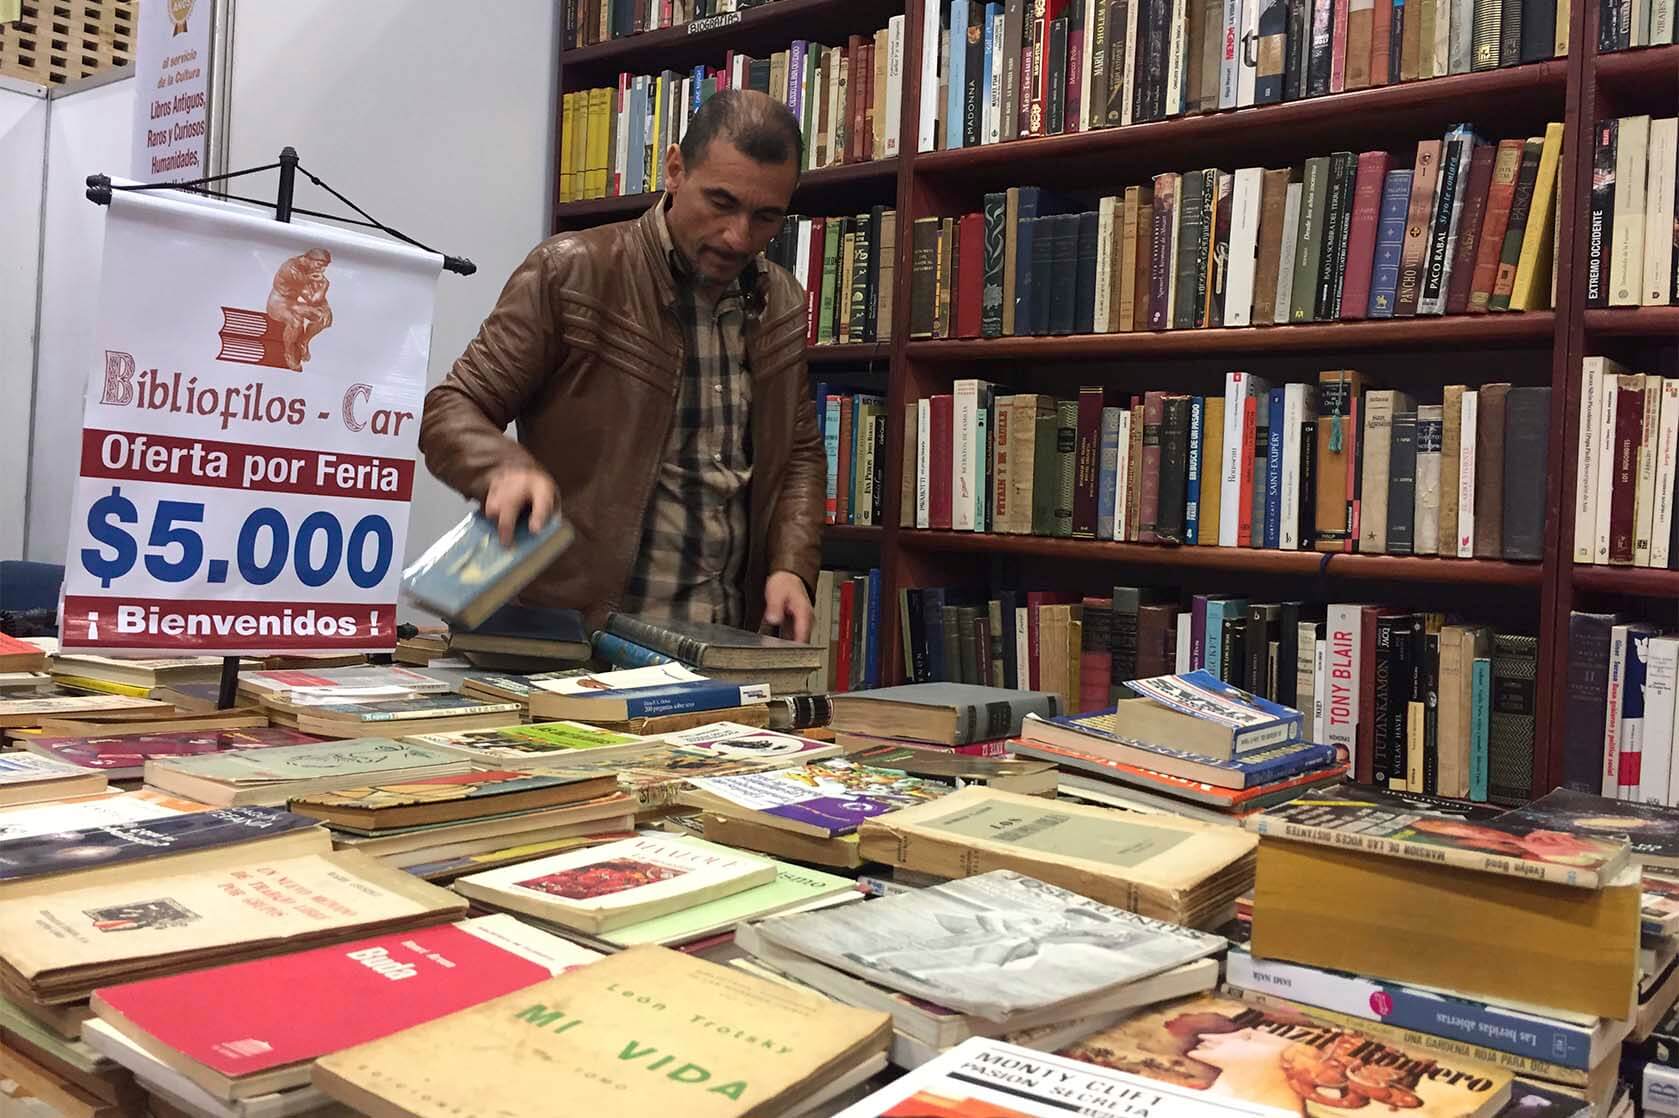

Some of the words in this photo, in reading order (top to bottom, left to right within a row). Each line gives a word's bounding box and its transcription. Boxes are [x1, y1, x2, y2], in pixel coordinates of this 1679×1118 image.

[1097, 8, 1106, 45] SHOLEM
[170, 49, 198, 67] servicio
[1093, 50, 1105, 76] MARÍA
[175, 67, 201, 84] Cultura
[151, 100, 172, 121] Libros
[172, 91, 207, 115] Antiguos,
[967, 79, 976, 135] MADONNA
[147, 130, 167, 148] Raros
[168, 131, 172, 147] y
[174, 119, 206, 142] Curiosos
[151, 149, 200, 175] Humanidades,
[1512, 180, 1530, 221] PASCAL
[1327, 223, 1337, 253] SOMBRA
[1432, 231, 1447, 261] RABAL
[1590, 209, 1603, 258] OCCIDENTE
[1400, 269, 1416, 303] PANCHO
[1430, 263, 1443, 290] PACO
[1588, 258, 1601, 299] EXTREMO
[1191, 403, 1200, 430] PASADO
[1190, 439, 1199, 449] DE
[101, 433, 228, 478] Oferta
[242, 451, 306, 487] por
[316, 454, 399, 492] Feria
[998, 467, 1006, 475] Y
[1189, 449, 1198, 471] BUSCA
[1269, 431, 1280, 496] SAINT-EXUPÉRY
[80, 486, 394, 589] $5.000
[116, 605, 358, 637] Bienvenidos
[369, 610, 380, 637] !
[1331, 631, 1353, 680] BLAIR
[1330, 683, 1352, 725] TONY
[1374, 658, 1390, 760] TUTANKAMÓN
[1382, 626, 1391, 648] JACQ
[1393, 712, 1402, 738] HAVEL
[1393, 742, 1402, 774] VACLAV
[988, 817, 1020, 830] LOS
[1285, 825, 1332, 844] DISTANTES
[1335, 832, 1364, 848] VOCES
[1366, 838, 1385, 852] LAS
[1388, 842, 1401, 854] DE
[1403, 845, 1446, 862] MANSION
[1484, 857, 1511, 874] Bond
[1513, 863, 1546, 879] Evelyn
[345, 945, 418, 981] Buda
[1273, 975, 1292, 988] SAMI
[605, 982, 668, 1012] León
[689, 1014, 794, 1055] Trotsky
[1435, 1012, 1478, 1034] abiertas
[1478, 1021, 1517, 1041] heridas
[514, 1003, 584, 1035] MI
[617, 1039, 752, 1102] VIDA
[1404, 1032, 1422, 1046] UNA
[1425, 1036, 1471, 1057] GARDENIA
[1500, 1053, 1525, 1069] PARA
[1519, 1031, 1538, 1047] Las
[960, 1061, 1040, 1089] PASION
[974, 1051, 1076, 1084] MONTY
[1085, 1080, 1165, 1107] CLIFT
